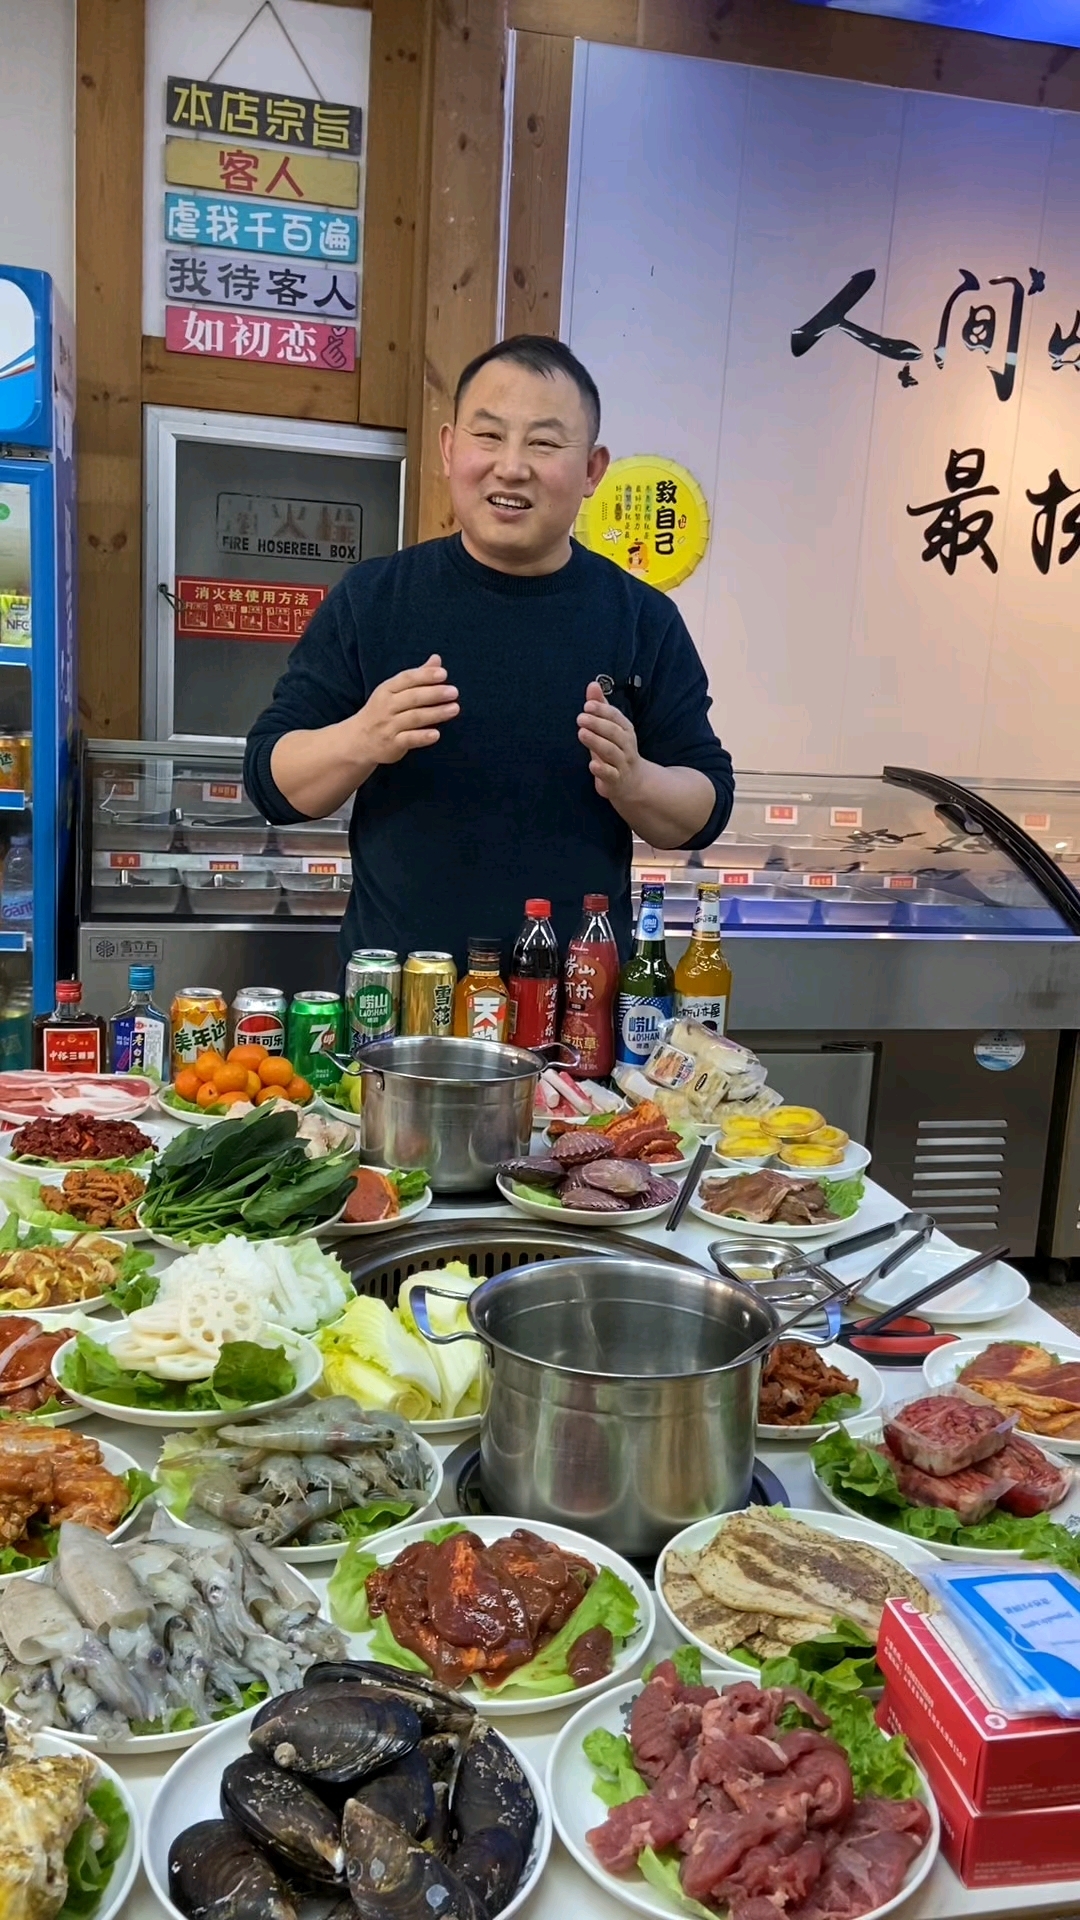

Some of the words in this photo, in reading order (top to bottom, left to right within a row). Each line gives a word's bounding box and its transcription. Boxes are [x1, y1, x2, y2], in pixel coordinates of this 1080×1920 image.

[172, 83, 350, 150] 本店宗旨
[218, 149, 304, 198] 客人
[168, 198, 351, 257] 虐我千百遍
[168, 257, 356, 311] 我待客人
[182, 310, 318, 363] 如初恋
[655, 479, 678, 555] 致自己
[222, 535, 250, 552] FIRE
[257, 538, 322, 558] HOSEREEL
[329, 544, 357, 560] BOX
[195, 586, 310, 606] 消火栓使用方法
[6, 618, 29, 631] NFC
[358, 1007, 389, 1018] LAOSHAN
[359, 993, 388, 1009] 崂山
[433, 985, 452, 1026] 雪花
[174, 1019, 227, 1053] 美年达
[628, 1016, 659, 1032] 崂山
[628, 1032, 660, 1042] LAOSHAN
